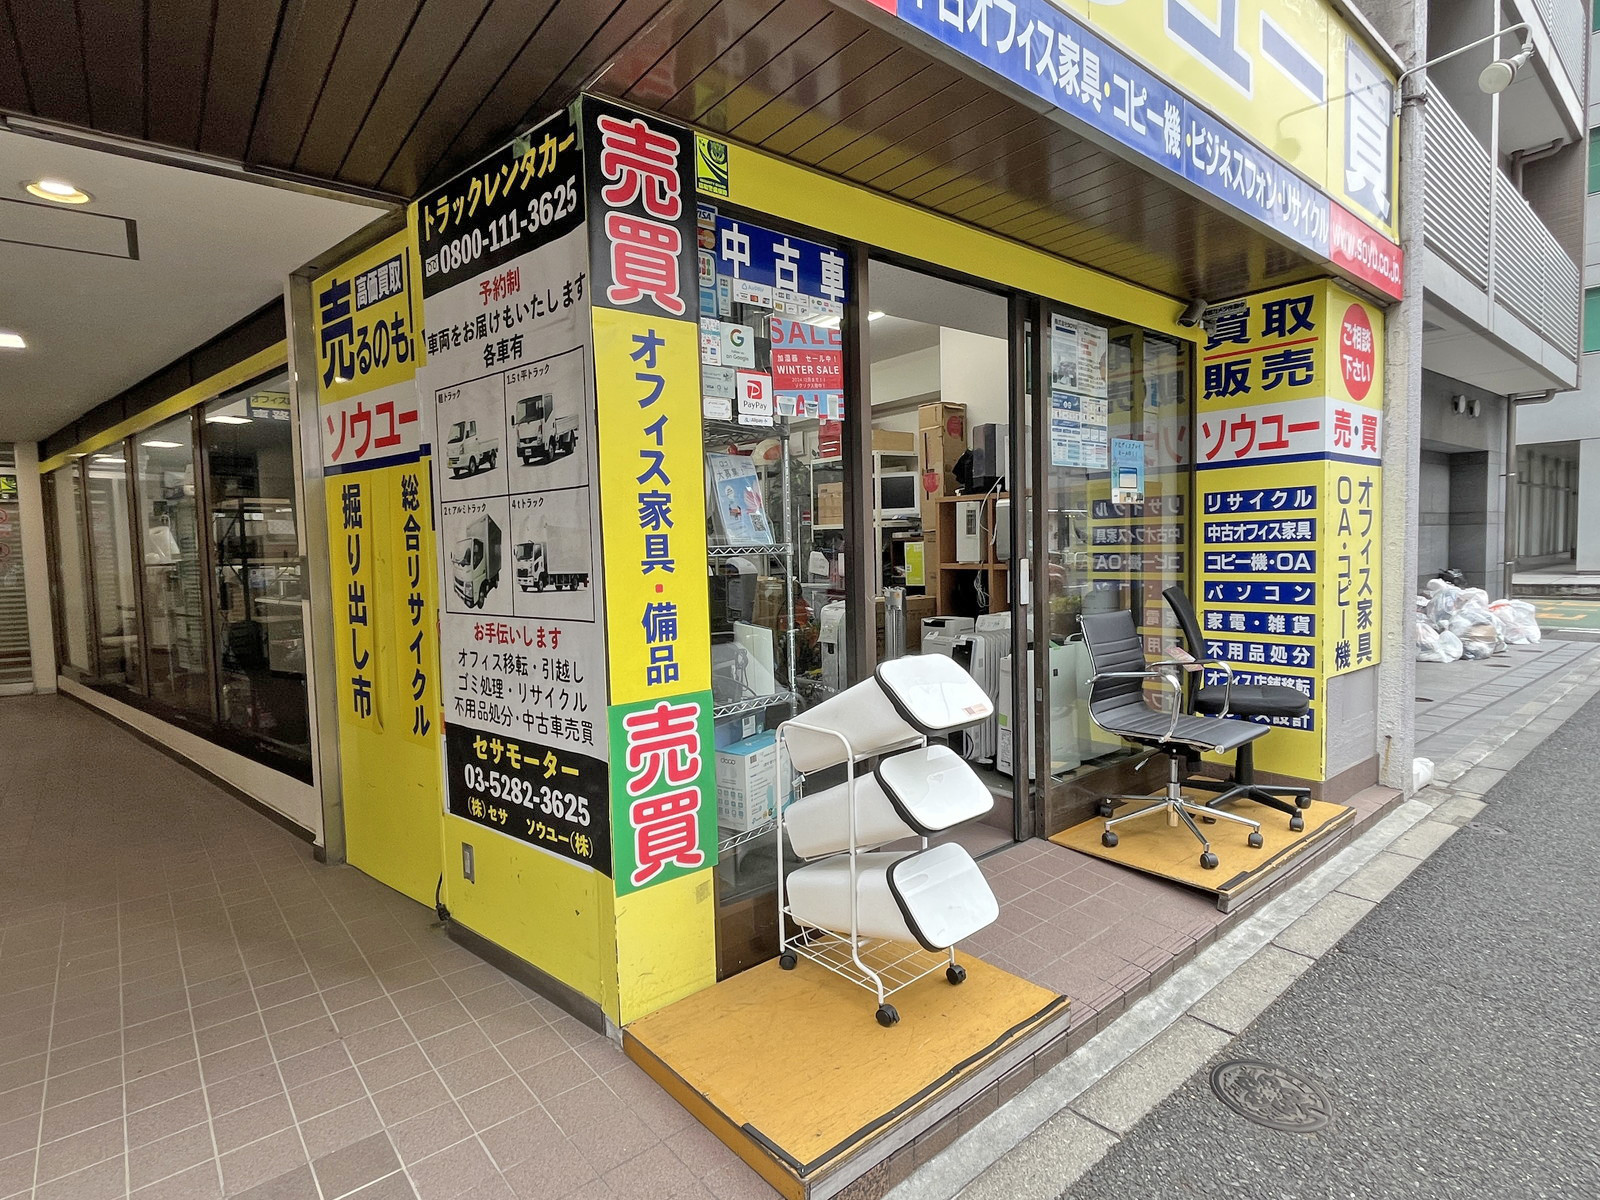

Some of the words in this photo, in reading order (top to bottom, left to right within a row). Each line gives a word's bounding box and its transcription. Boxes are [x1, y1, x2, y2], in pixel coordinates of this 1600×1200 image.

[917, 0, 1329, 244] 古オフィス家具・コピー機・ビジネスフォン・リサイクル
[424, 132, 575, 242] トラックレンタカー
[440, 175, 578, 274] 0800-111-3625
[597, 114, 686, 316] 売買
[356, 259, 402, 310] 高価買取
[478, 266, 521, 306] 予約制
[721, 223, 845, 303] 中古車
[427, 271, 587, 357] 車両をお届けもいたします
[770, 317, 842, 345] SALE
[1203, 295, 1316, 351] 買取
[483, 333, 524, 369] 各車有
[1343, 322, 1371, 353] ご相談
[777, 365, 813, 374] WINTER
[816, 366, 840, 375] SALE
[1203, 349, 1314, 400] 販売
[1342, 354, 1371, 383] 下さい
[743, 401, 767, 410] PayPay
[327, 400, 419, 462] ソウユー
[1202, 413, 1320, 461] ソウユー
[1334, 408, 1378, 453] 売・買
[629, 328, 681, 688] オフィス家具・備品
[1207, 490, 1312, 512] リサイクル
[1207, 522, 1312, 542] 中古オフィス家具
[1207, 553, 1311, 571] コピー機・OA
[1357, 476, 1373, 665] オフィス家具
[342, 483, 372, 719] 掘り出し市
[401, 474, 430, 737] 総合リサイクル
[1207, 585, 1311, 602] パソコン
[474, 622, 562, 650] お手伝いします
[1207, 613, 1311, 635] 家電・雑貨
[458, 648, 584, 684] オフィス移転・引越し
[1207, 641, 1311, 665] 不用品処分
[458, 674, 588, 713] ゴミ処理・リサイクル
[454, 696, 594, 747] 不用品処分・中古車売買
[472, 735, 580, 780] セサモーター
[464, 763, 592, 827] 03-5282-3625
[625, 699, 704, 887] 売買
